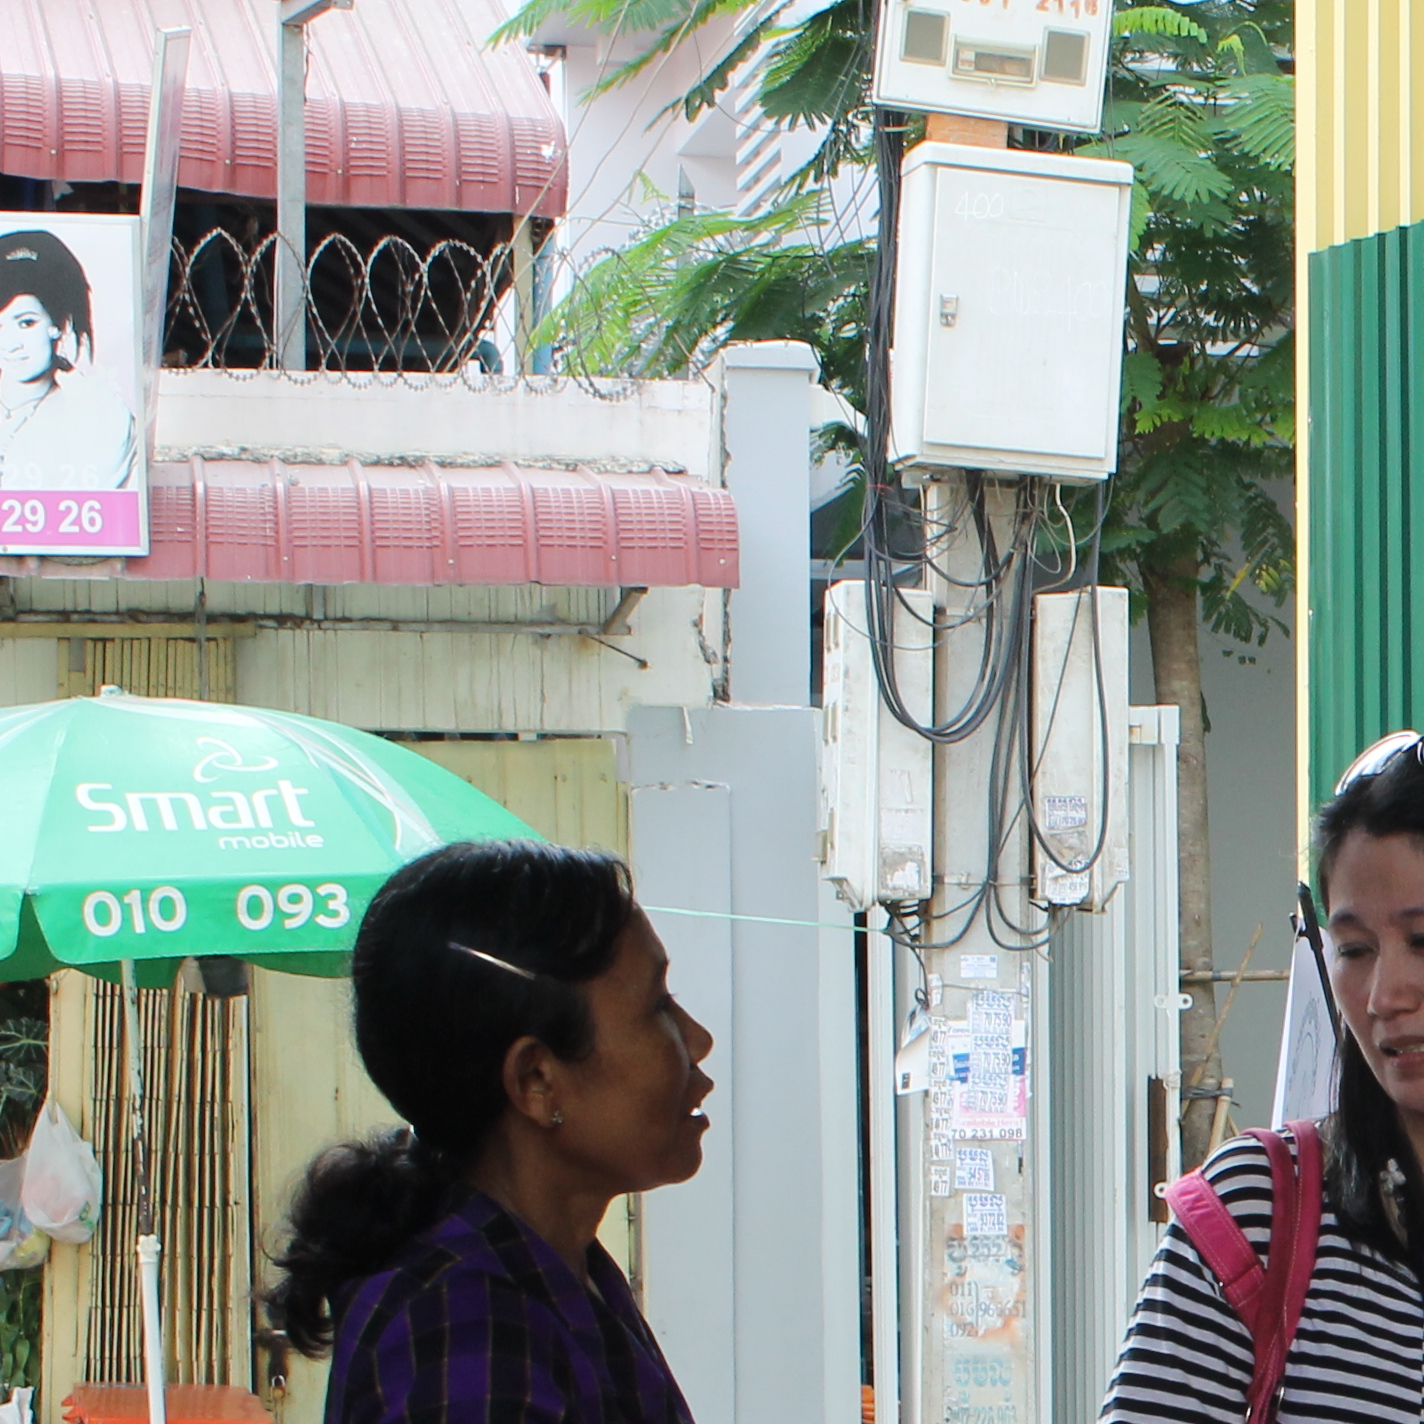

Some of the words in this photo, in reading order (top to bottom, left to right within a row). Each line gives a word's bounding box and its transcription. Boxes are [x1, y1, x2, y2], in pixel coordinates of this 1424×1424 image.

[1, 499, 46, 533] 29
[58, 500, 103, 533] 26
[76, 780, 315, 832] Smart
[219, 832, 324, 849] mobile
[83, 886, 187, 937] 010
[236, 883, 350, 930] 093
[971, 1129, 993, 1139] 231
